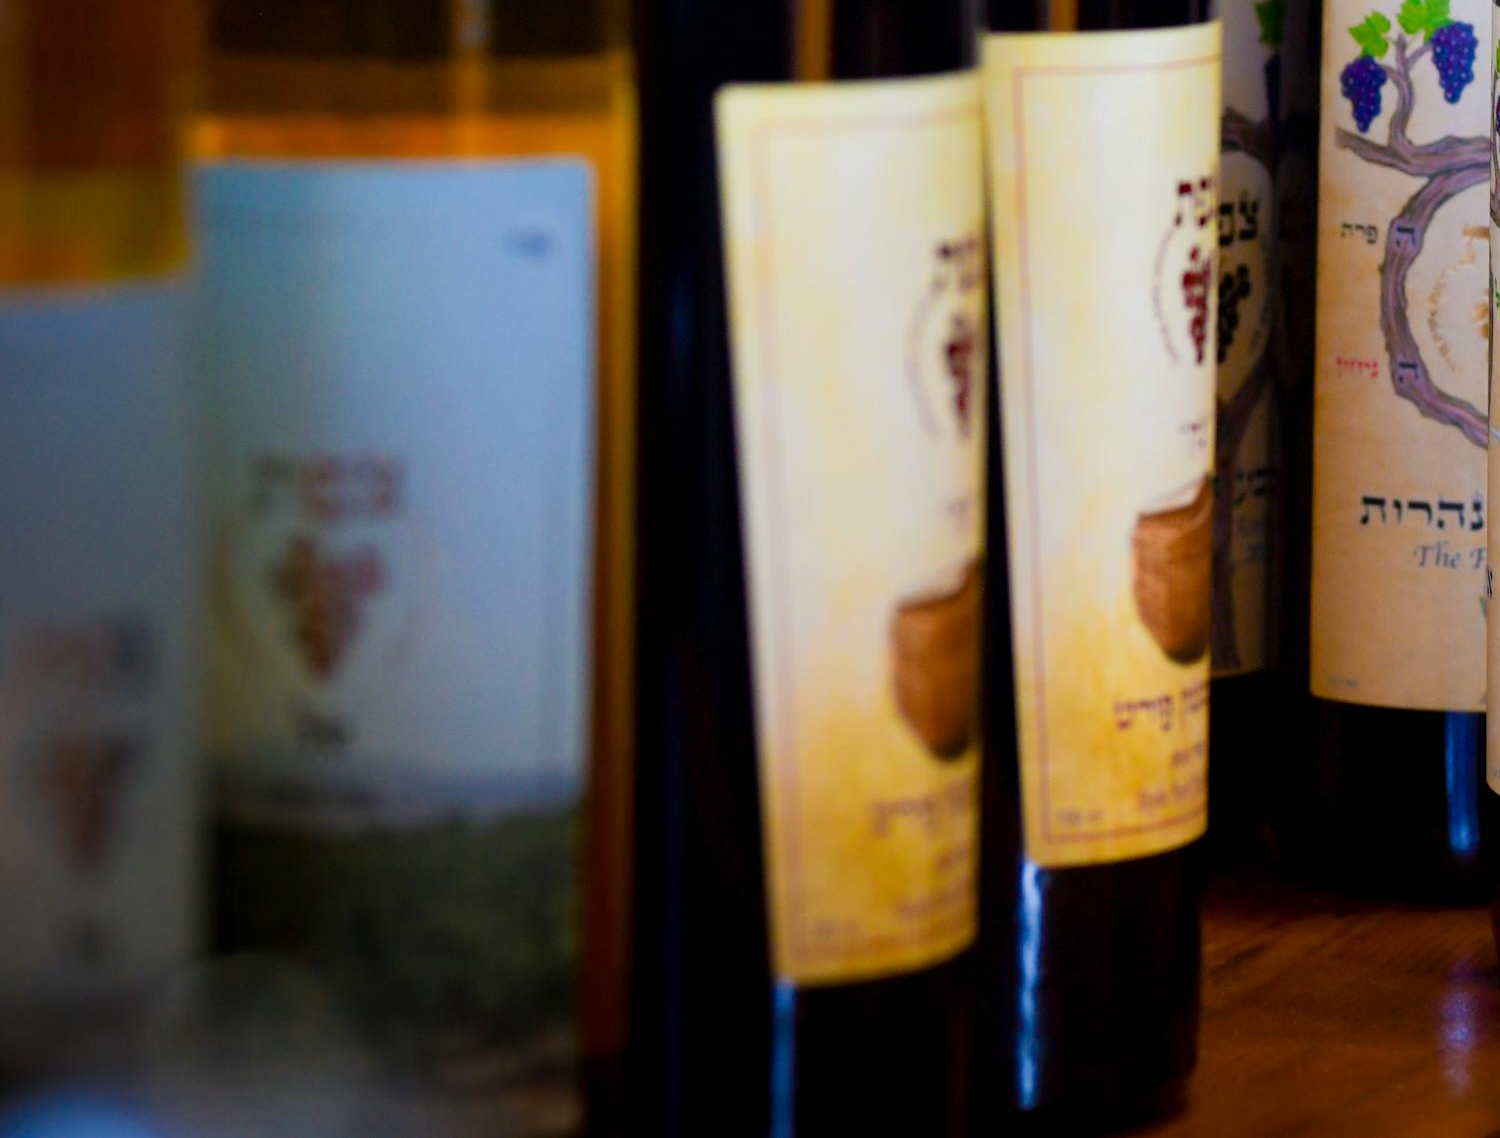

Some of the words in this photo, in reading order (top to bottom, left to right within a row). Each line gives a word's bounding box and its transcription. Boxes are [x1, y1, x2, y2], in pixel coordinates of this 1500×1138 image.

[1218, 196, 1260, 247] צפ
[1361, 492, 1485, 530] נהרות
[1412, 541, 1462, 568] The
